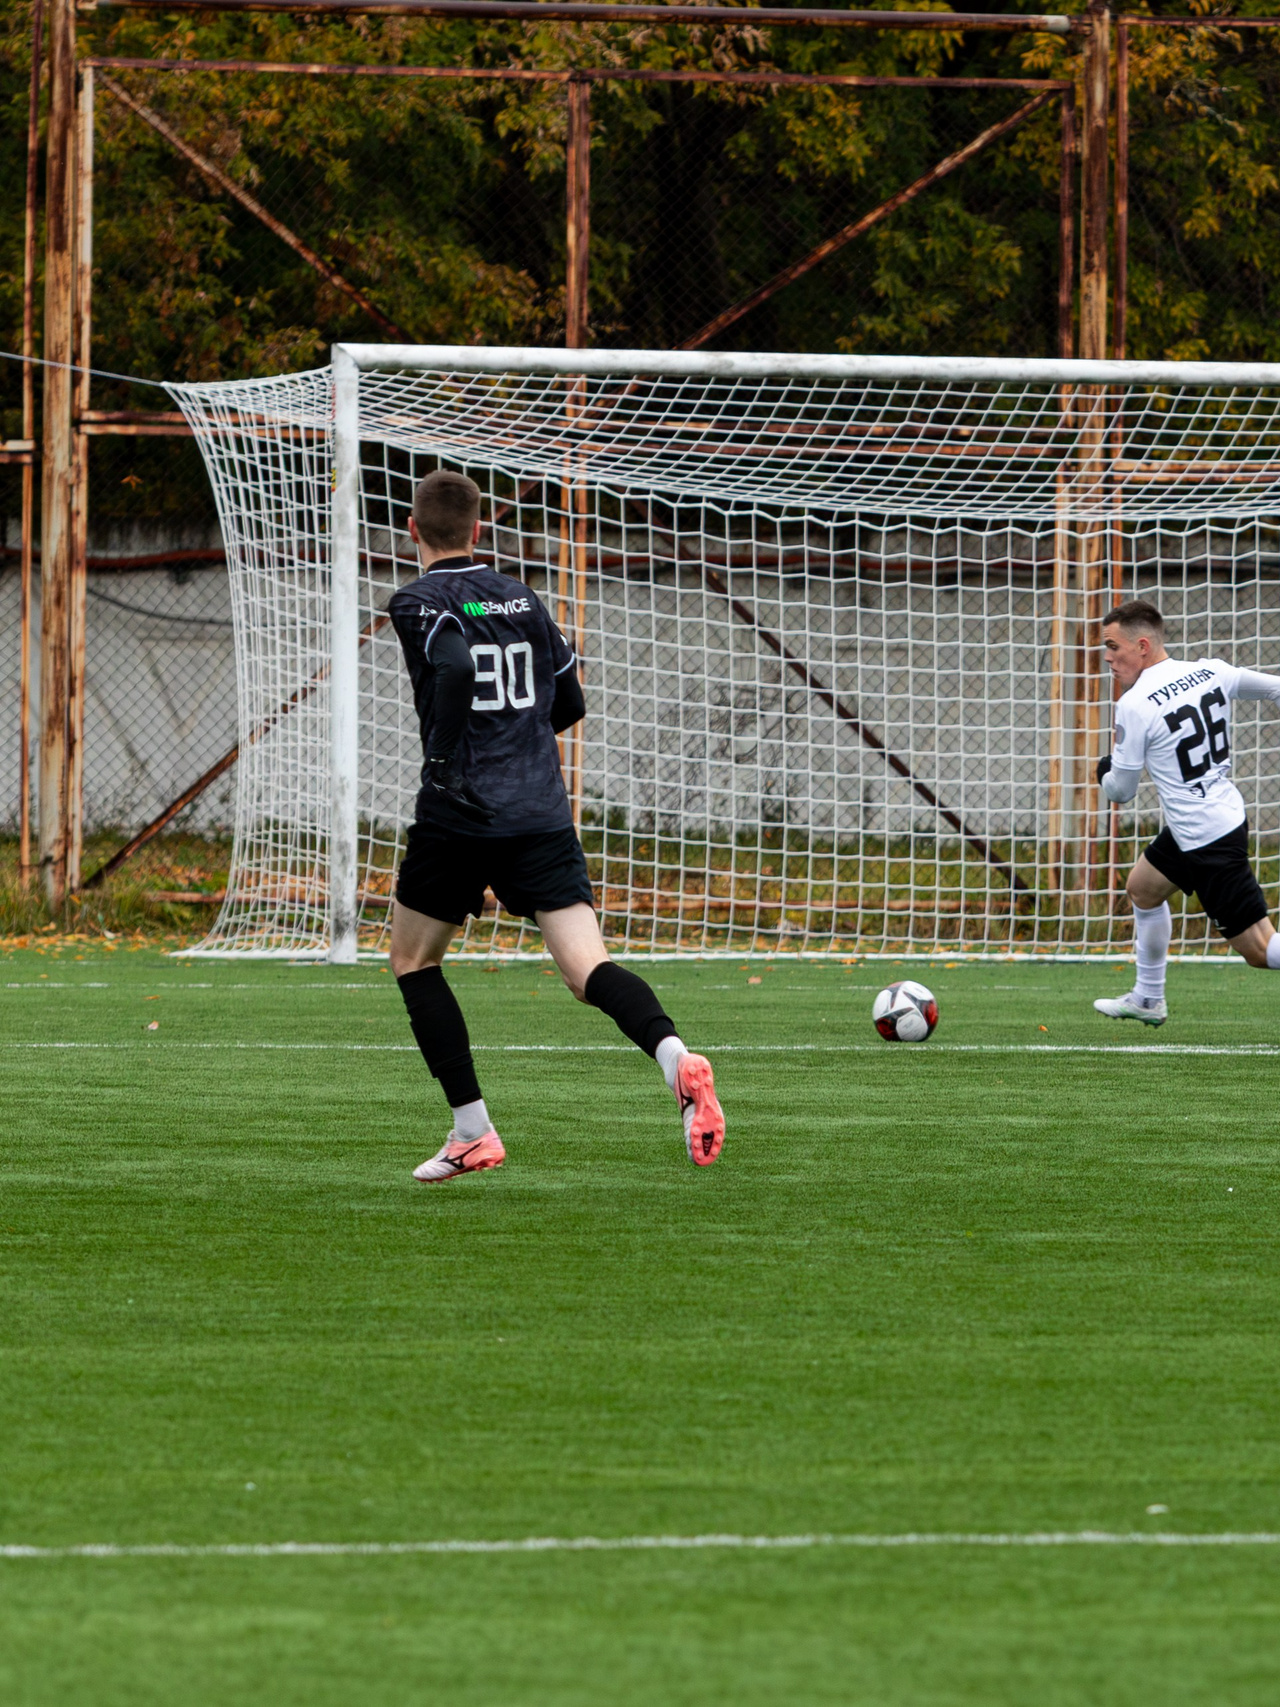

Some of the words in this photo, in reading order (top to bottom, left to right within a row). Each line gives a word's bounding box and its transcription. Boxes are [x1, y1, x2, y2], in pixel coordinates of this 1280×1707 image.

[469, 641, 536, 711] 90
[1147, 667, 1216, 706] ТУРБИНА
[1163, 686, 1229, 783] 26
